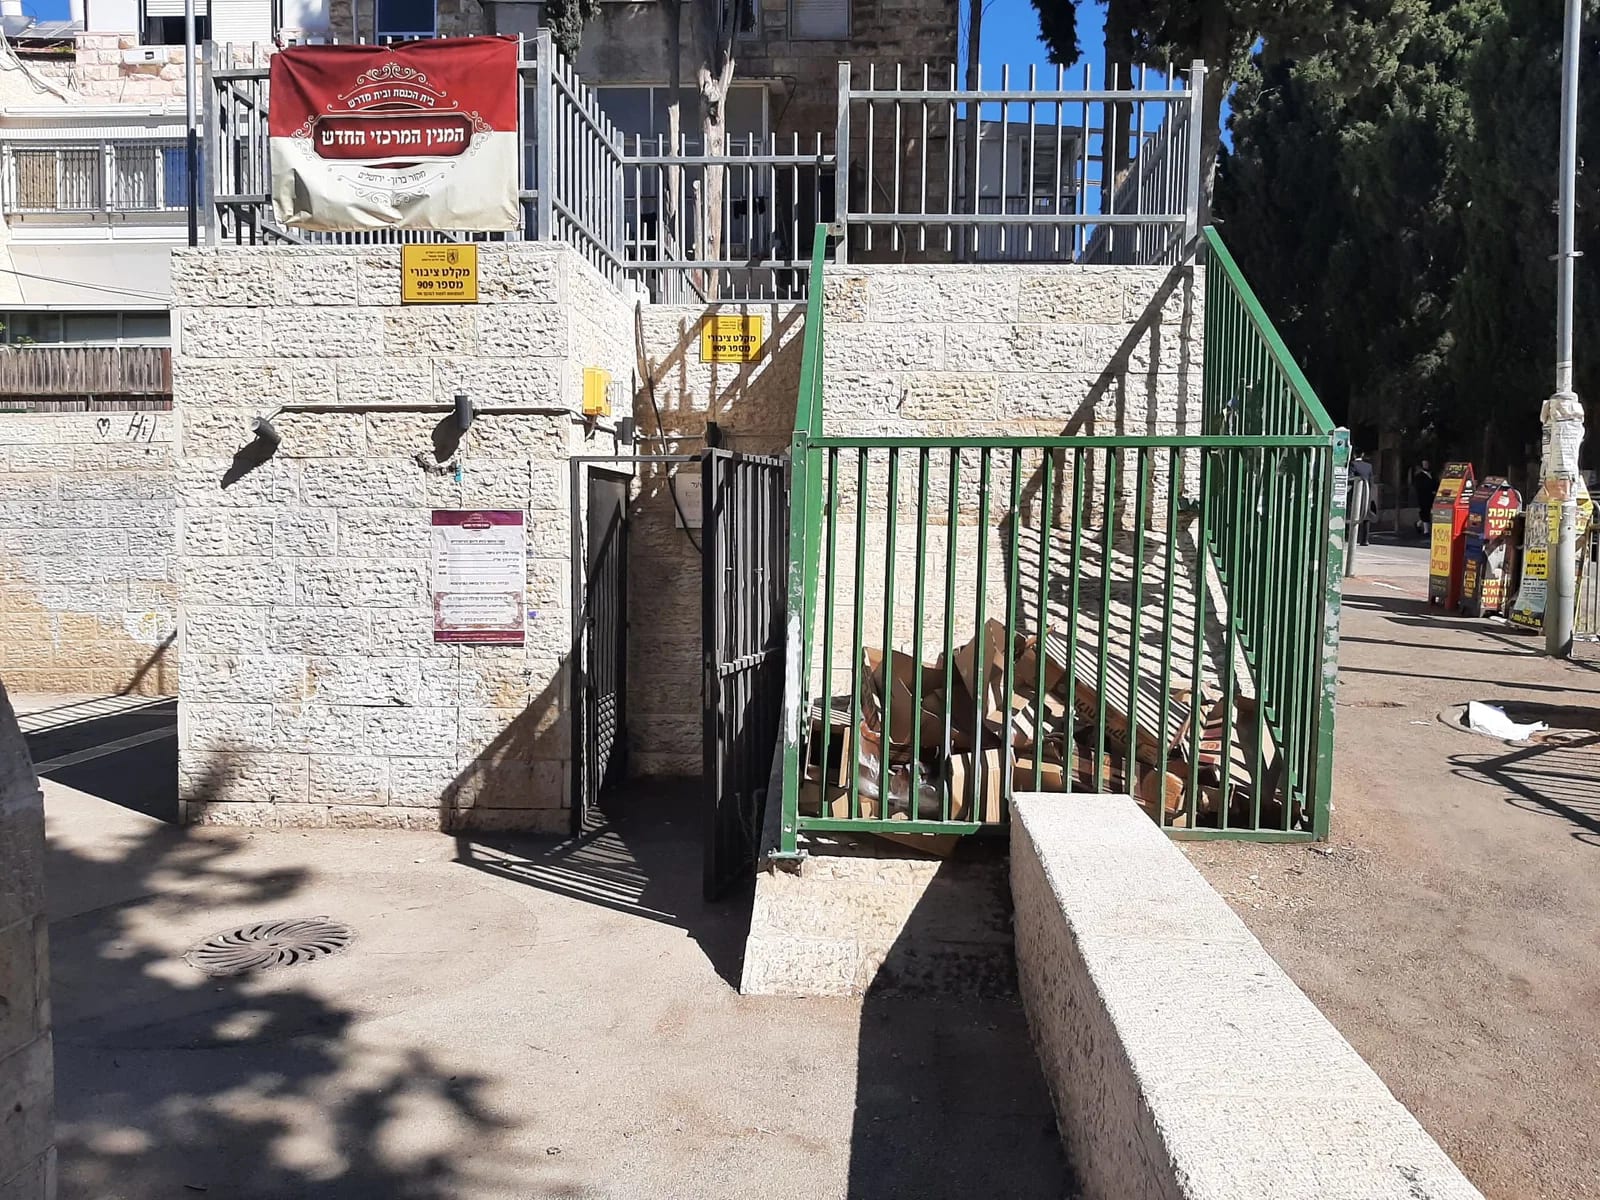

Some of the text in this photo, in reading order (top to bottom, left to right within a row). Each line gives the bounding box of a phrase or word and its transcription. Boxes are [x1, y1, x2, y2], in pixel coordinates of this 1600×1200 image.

[347, 89, 435, 108] בית הכנסת ובית מדרש
[321, 127, 465, 147] המנין המרכזי החדש
[358, 171, 385, 182] ירושלים
[408, 170, 426, 182] מקור
[410, 266, 470, 279] מקלט ציבורי
[416, 280, 464, 290] מספר 909
[707, 333, 757, 343] מקלט ציבורי
[1487, 508, 1517, 519] קופת
[1488, 519, 1514, 529] העיר
